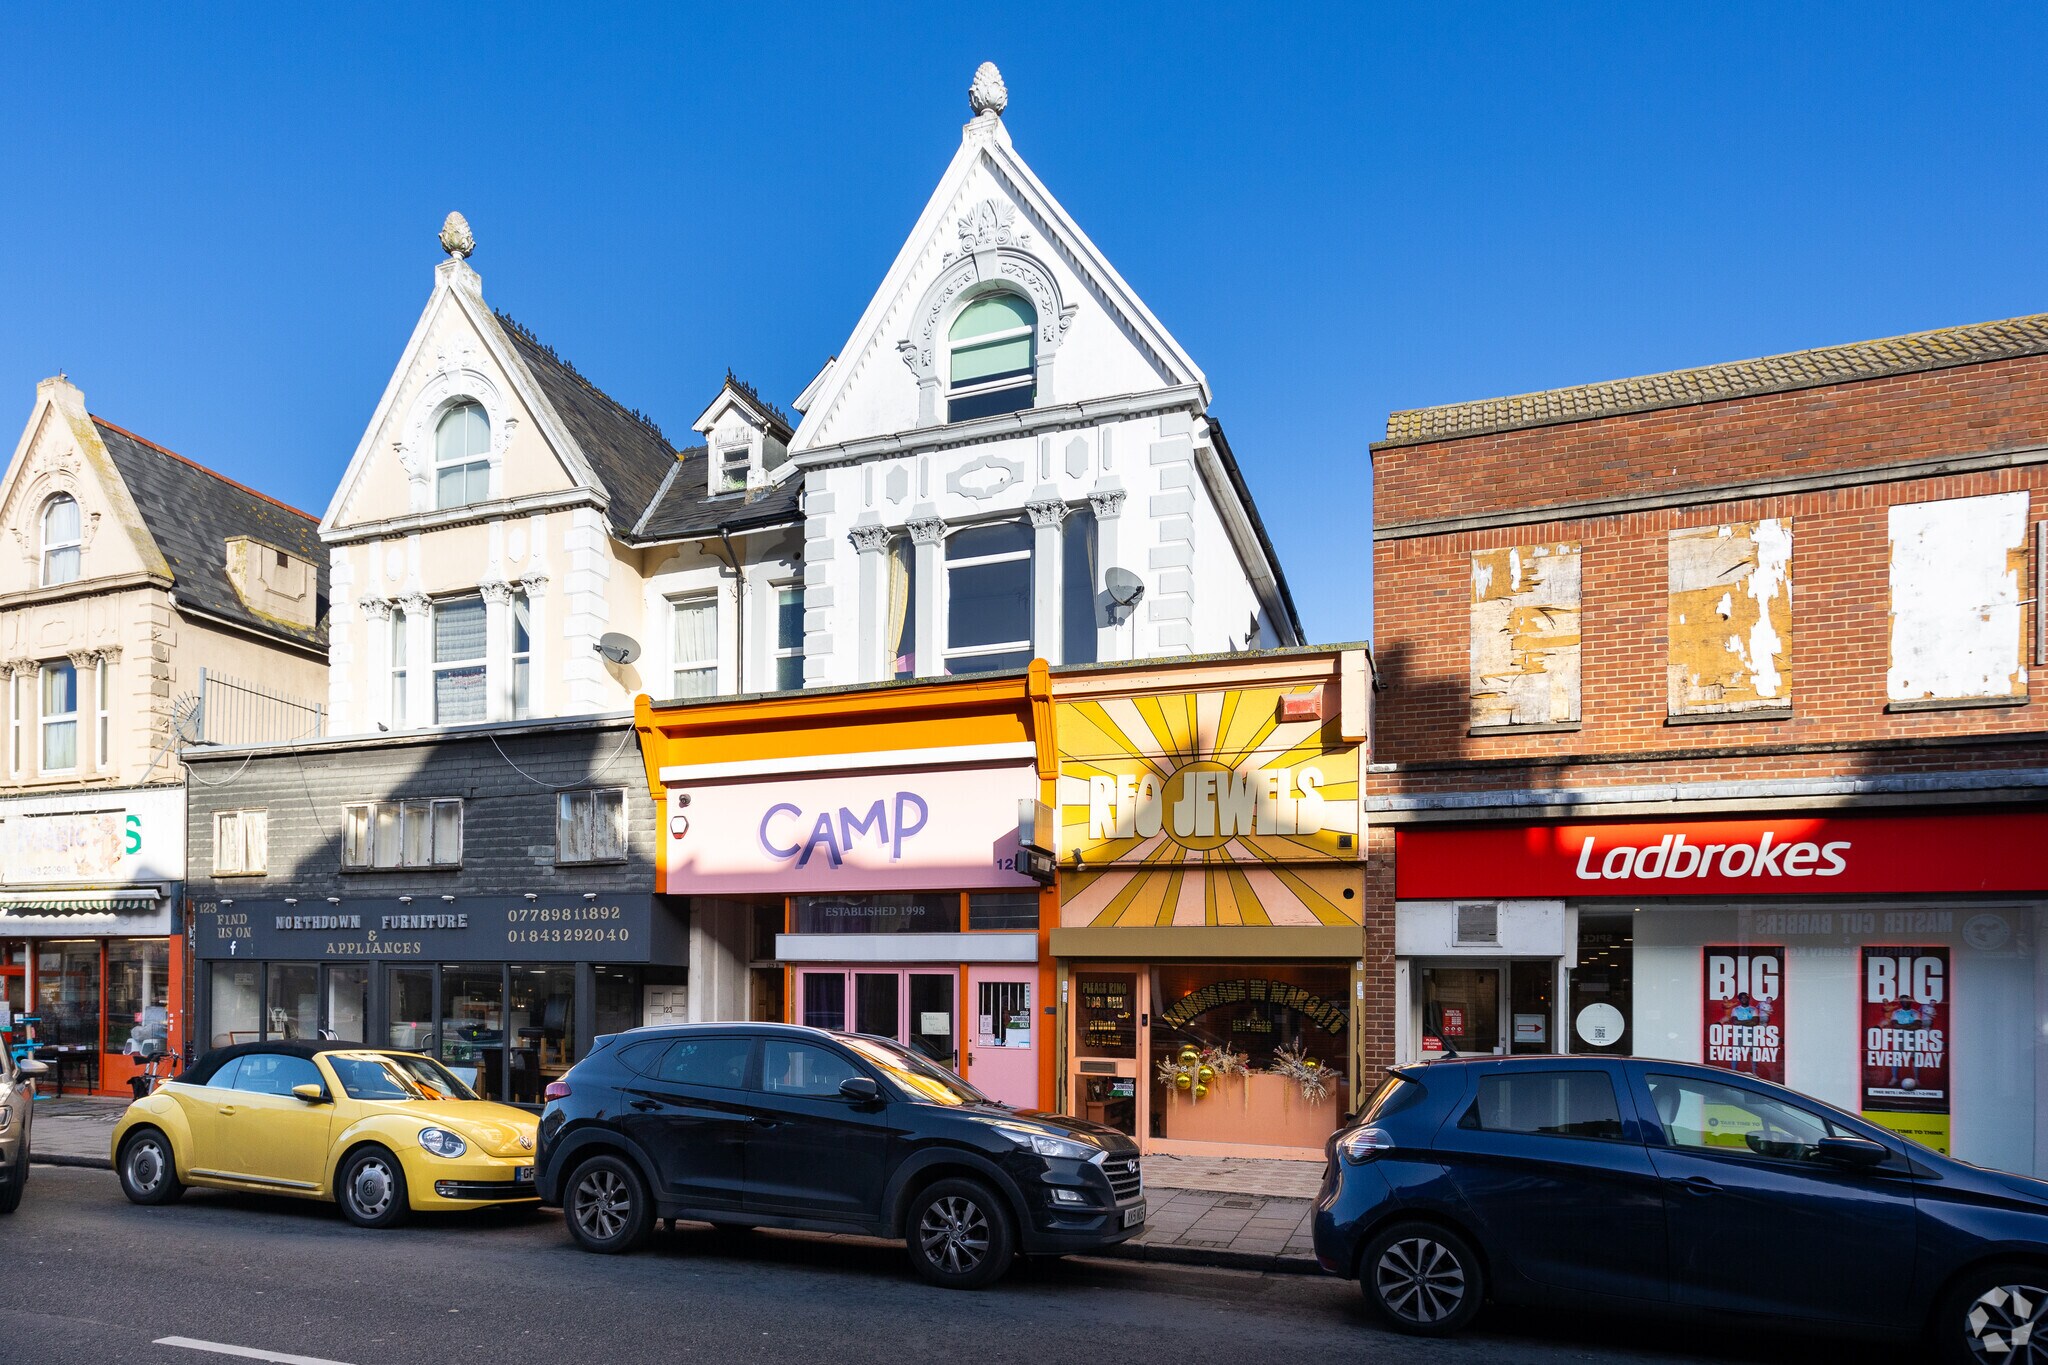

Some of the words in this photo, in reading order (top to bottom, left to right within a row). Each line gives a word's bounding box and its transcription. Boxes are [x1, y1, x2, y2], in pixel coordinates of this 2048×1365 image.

[1088, 772, 1163, 839] REO
[1172, 766, 1325, 838] JEWELS
[760, 791, 929, 866] CAMP
[997, 858, 1016, 870] 12
[1575, 831, 1852, 880] Ladbrokes
[199, 902, 217, 914] 123
[507, 906, 621, 922] 07789811892
[825, 906, 897, 917] ESTABLISHED
[900, 906, 926, 916] 1998
[216, 913, 248, 925] FIND
[275, 914, 361, 930] NORTHDOWN
[381, 913, 468, 930] FURNITURE
[217, 927, 233, 938] US
[235, 927, 252, 938] ON
[367, 930, 378, 941] &
[507, 928, 629, 943] 01843292040
[325, 941, 421, 954] APPLIANCES
[1709, 955, 1779, 1001] BIG
[1867, 956, 1943, 1005] BIG
[1082, 982, 1107, 994] PLEASE
[1108, 982, 1127, 994] RING
[1160, 979, 1246, 1032] HANDMADE
[1249, 979, 1269, 1001] IN
[1270, 980, 1350, 1036] MARGATE
[1709, 1023, 1779, 1047] OFFERS
[1867, 1027, 1943, 1052] OFFERS
[1709, 1045, 1750, 1062] EVERY
[1867, 1050, 1912, 1067] EVERY
